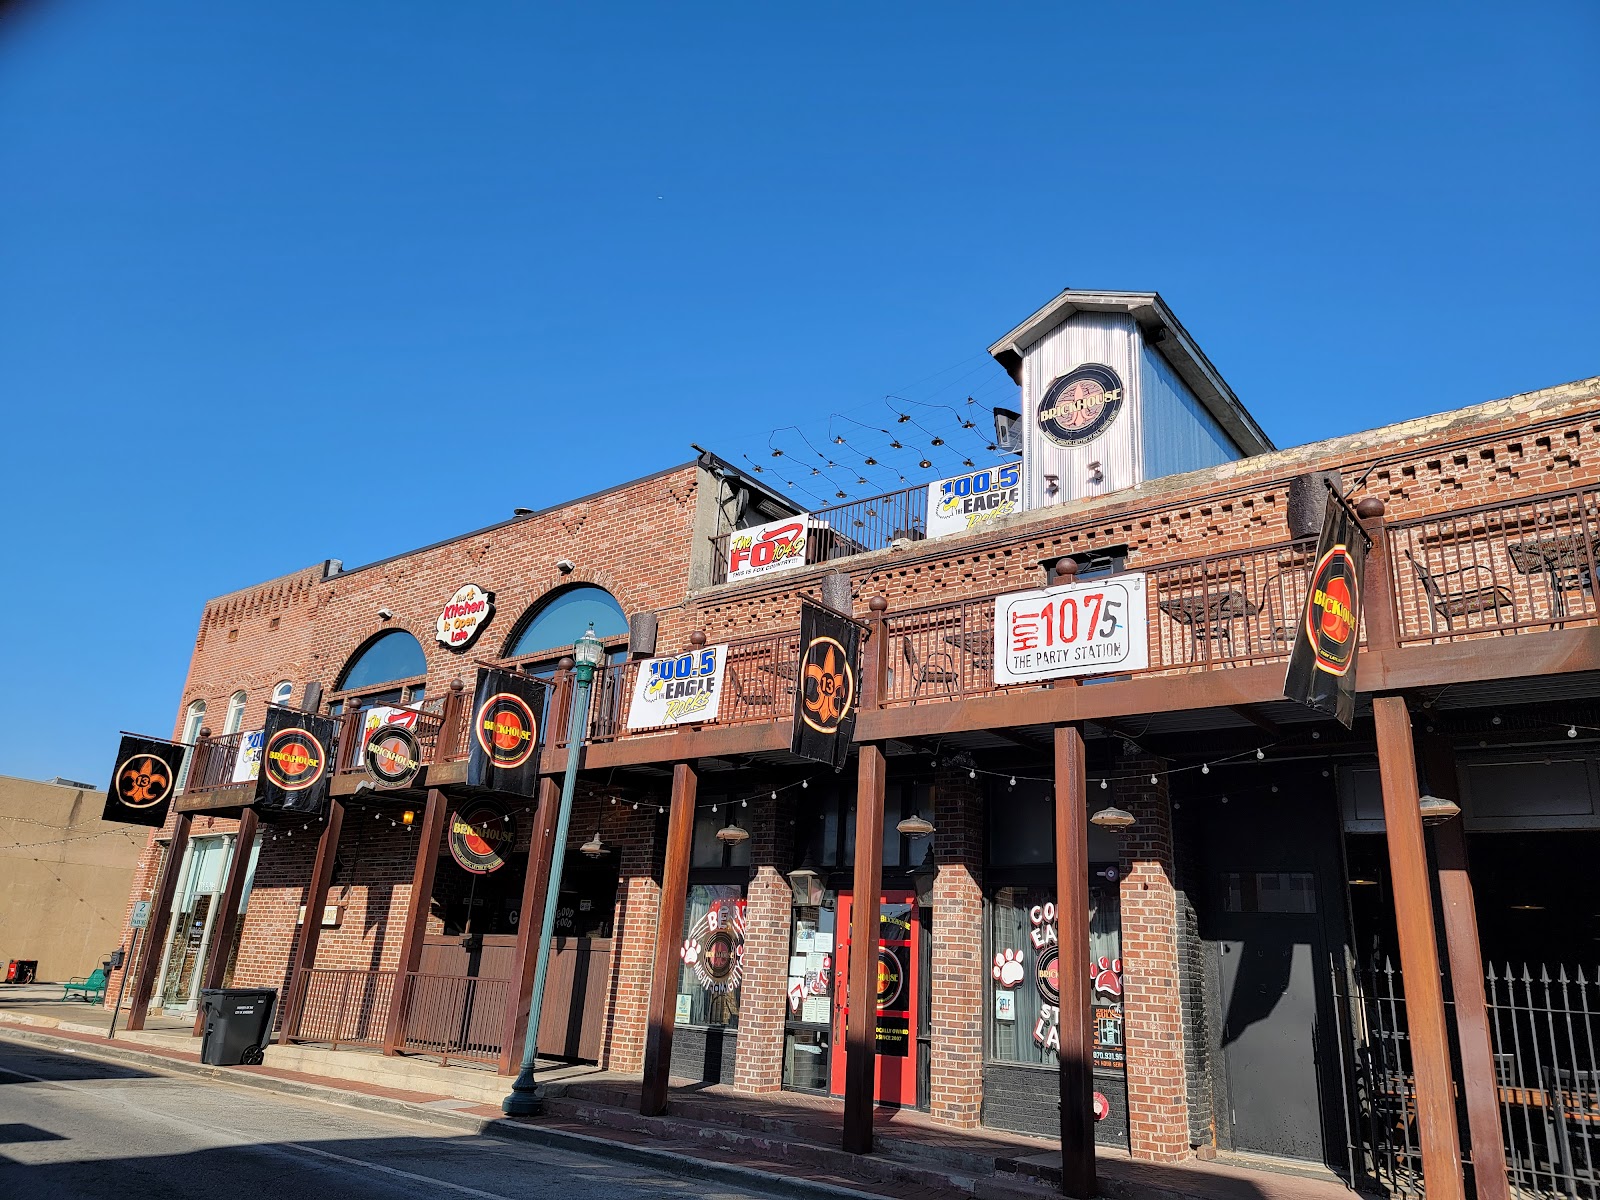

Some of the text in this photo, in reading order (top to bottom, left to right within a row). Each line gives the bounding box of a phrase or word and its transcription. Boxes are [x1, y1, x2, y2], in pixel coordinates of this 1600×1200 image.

[1040, 388, 1121, 422] BRICKHOUSE
[940, 463, 1020, 498] 100.5
[963, 488, 1019, 514] EAGLE
[730, 536, 804, 573] FOX
[732, 570, 745, 578] THIS
[752, 566, 764, 574] FOX
[443, 600, 485, 620] Kitchen
[453, 617, 477, 629] Open
[1012, 611, 1040, 652] HOT
[451, 630, 469, 642] Late
[649, 648, 717, 682] 100.5
[1013, 642, 1122, 669] THE PARTY STATION
[665, 677, 716, 699] EAGLE
[821, 676, 835, 694] 13
[662, 688, 712, 724] Rocks
[483, 720, 532, 740] BRCKHOUSE
[269, 750, 319, 768] BRICKHOUSE
[368, 742, 419, 770] BRICKHOUSE
[136, 776, 150, 786] 13
[453, 822, 514, 841] BRICKHOUSE
[1030, 902, 1058, 925] CO
[878, 973, 899, 981] HOUSE
